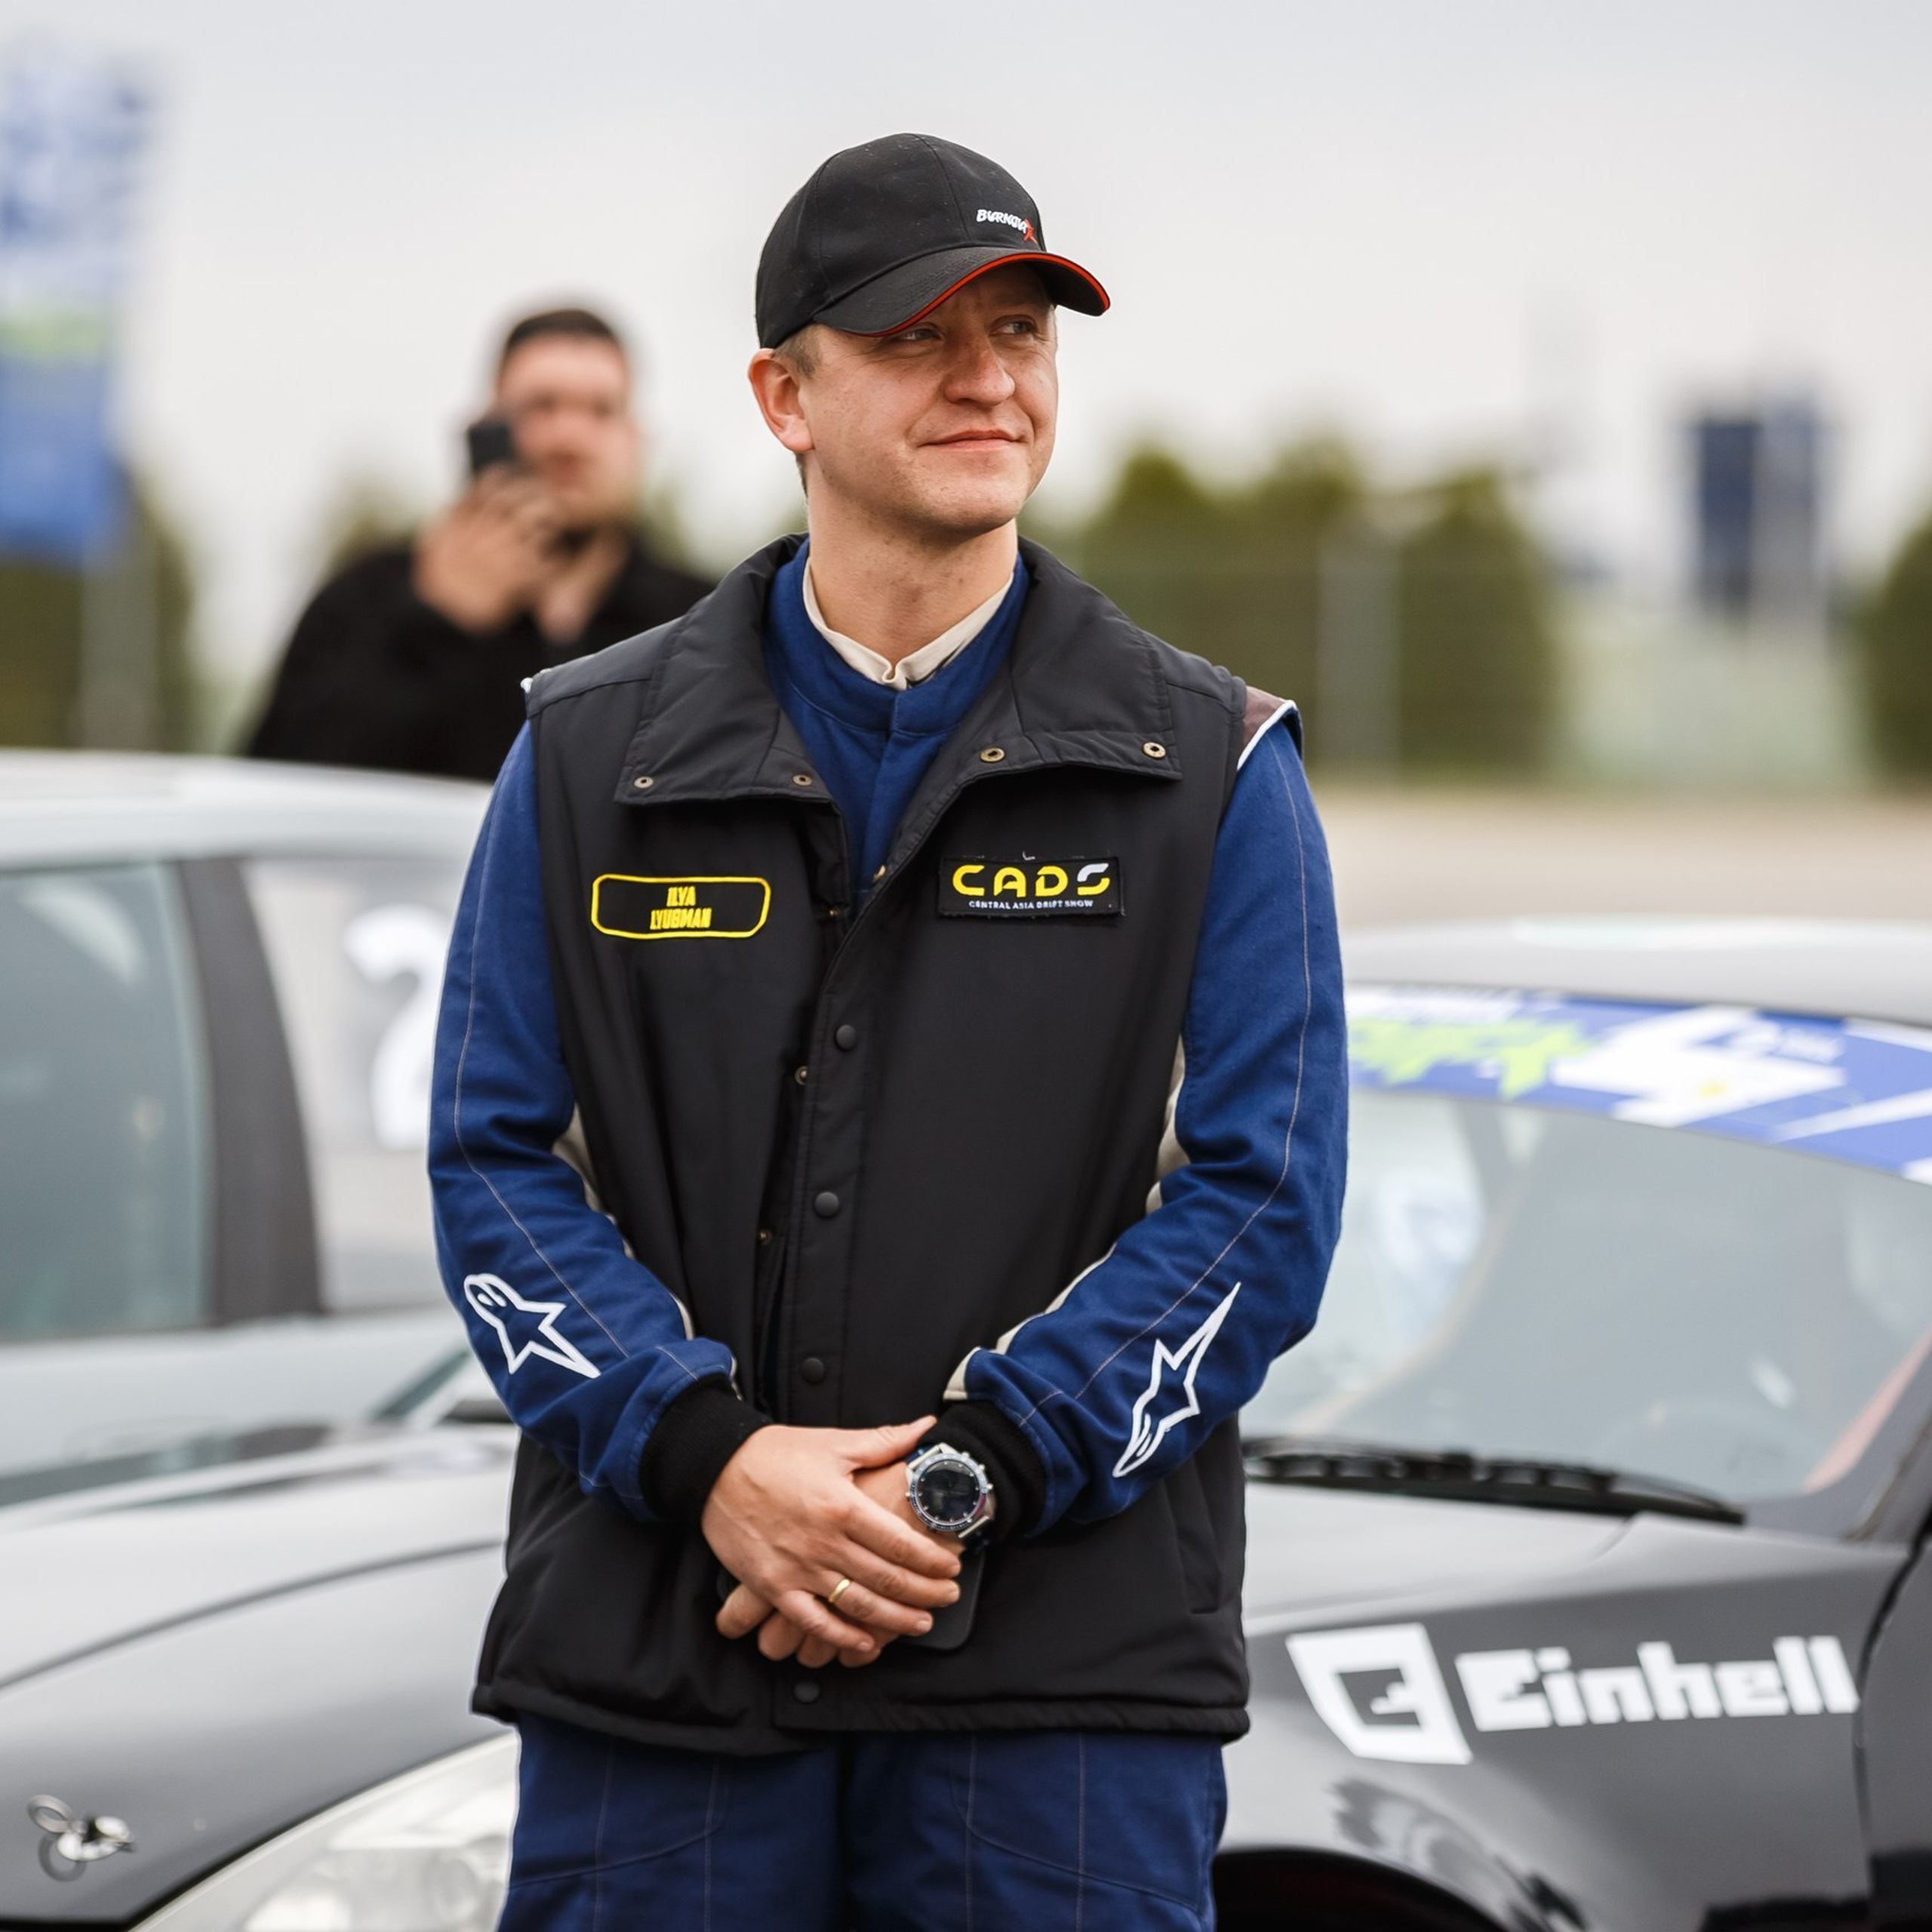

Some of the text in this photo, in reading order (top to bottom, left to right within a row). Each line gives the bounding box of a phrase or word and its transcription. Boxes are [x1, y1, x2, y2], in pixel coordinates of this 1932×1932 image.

[952, 863, 1110, 897] CADS
[666, 886, 696, 907] ILYA
[968, 900, 1011, 909] CENTRAL
[1035, 900, 1063, 909] DRIFT
[1064, 899, 1094, 908] SHOW
[650, 907, 712, 930] LYUBMAN
[1454, 1635, 1860, 1732] Einhell
